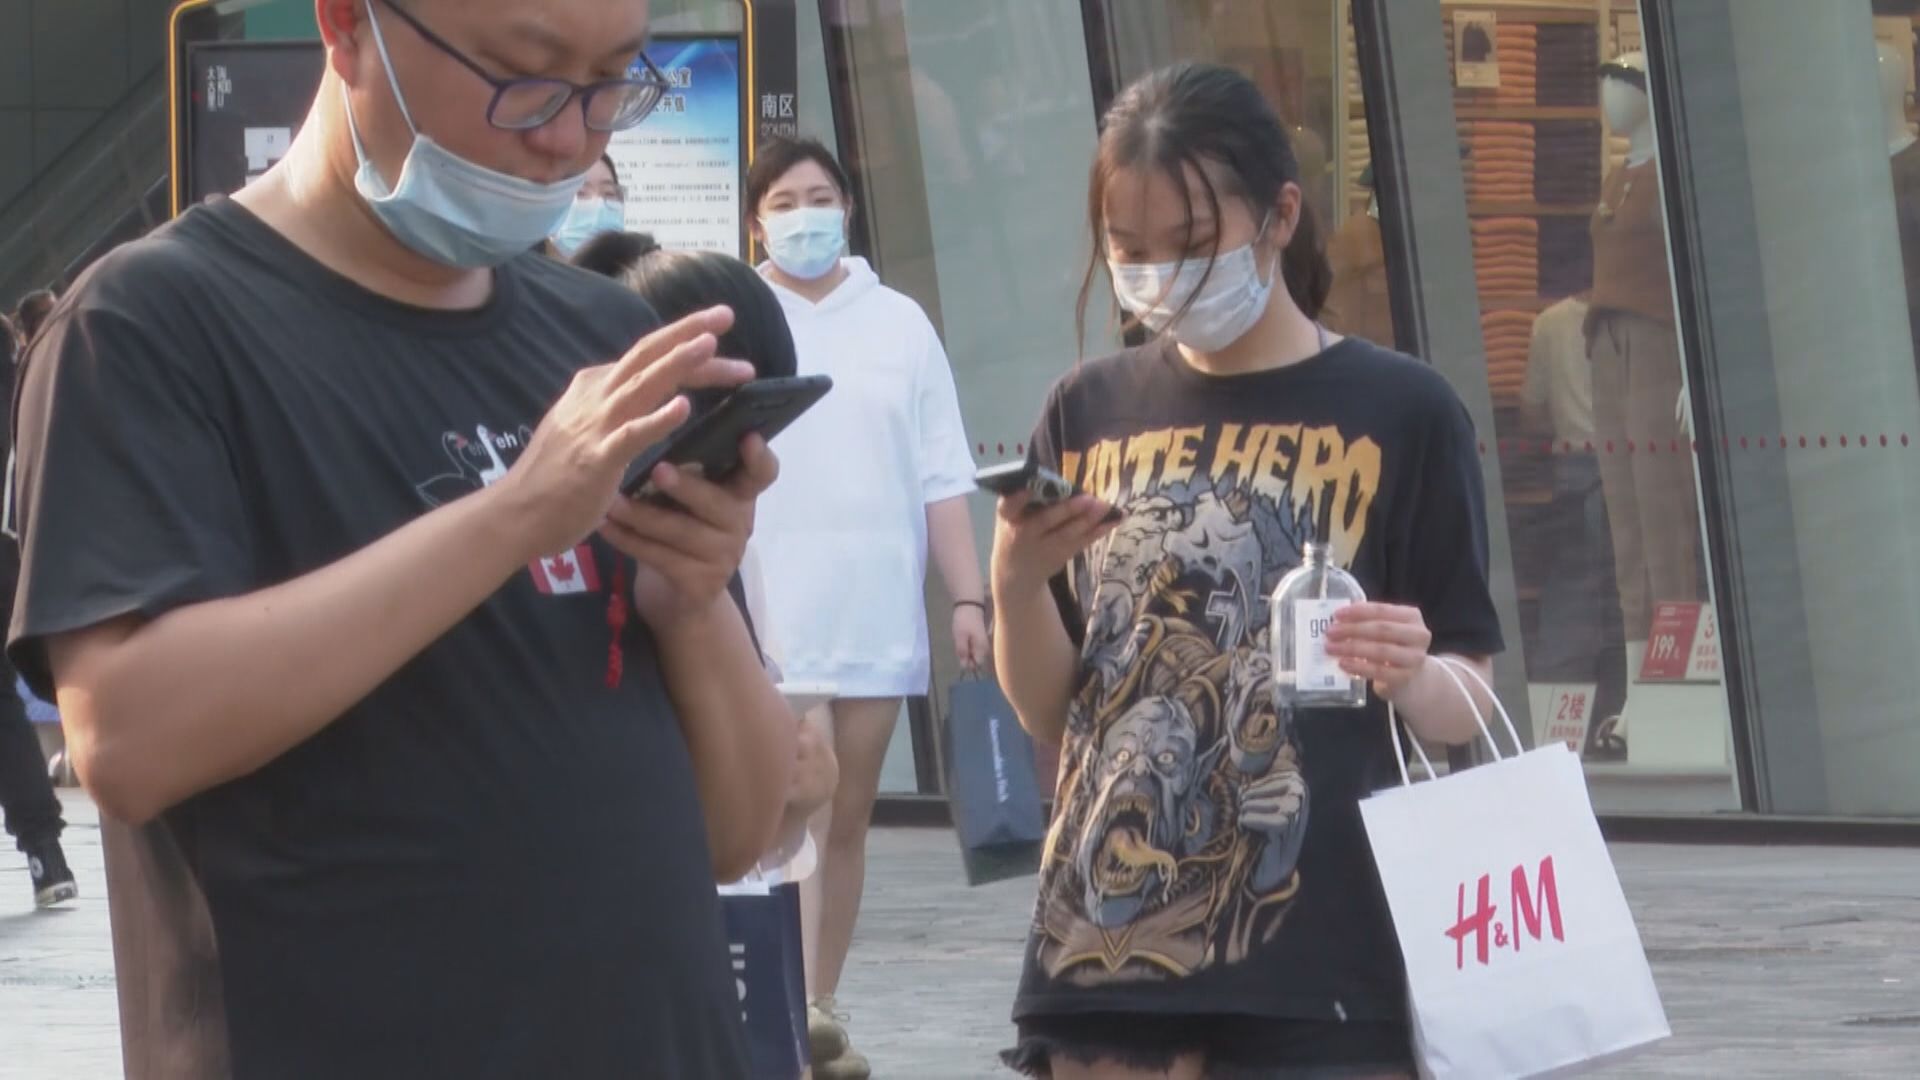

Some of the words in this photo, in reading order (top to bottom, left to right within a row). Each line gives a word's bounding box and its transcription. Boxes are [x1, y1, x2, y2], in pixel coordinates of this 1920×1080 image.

[761, 93, 794, 119] 南区
[496, 431, 518, 450] eh
[1210, 422, 1382, 570] HERO
[1444, 854, 1565, 970] H&M
